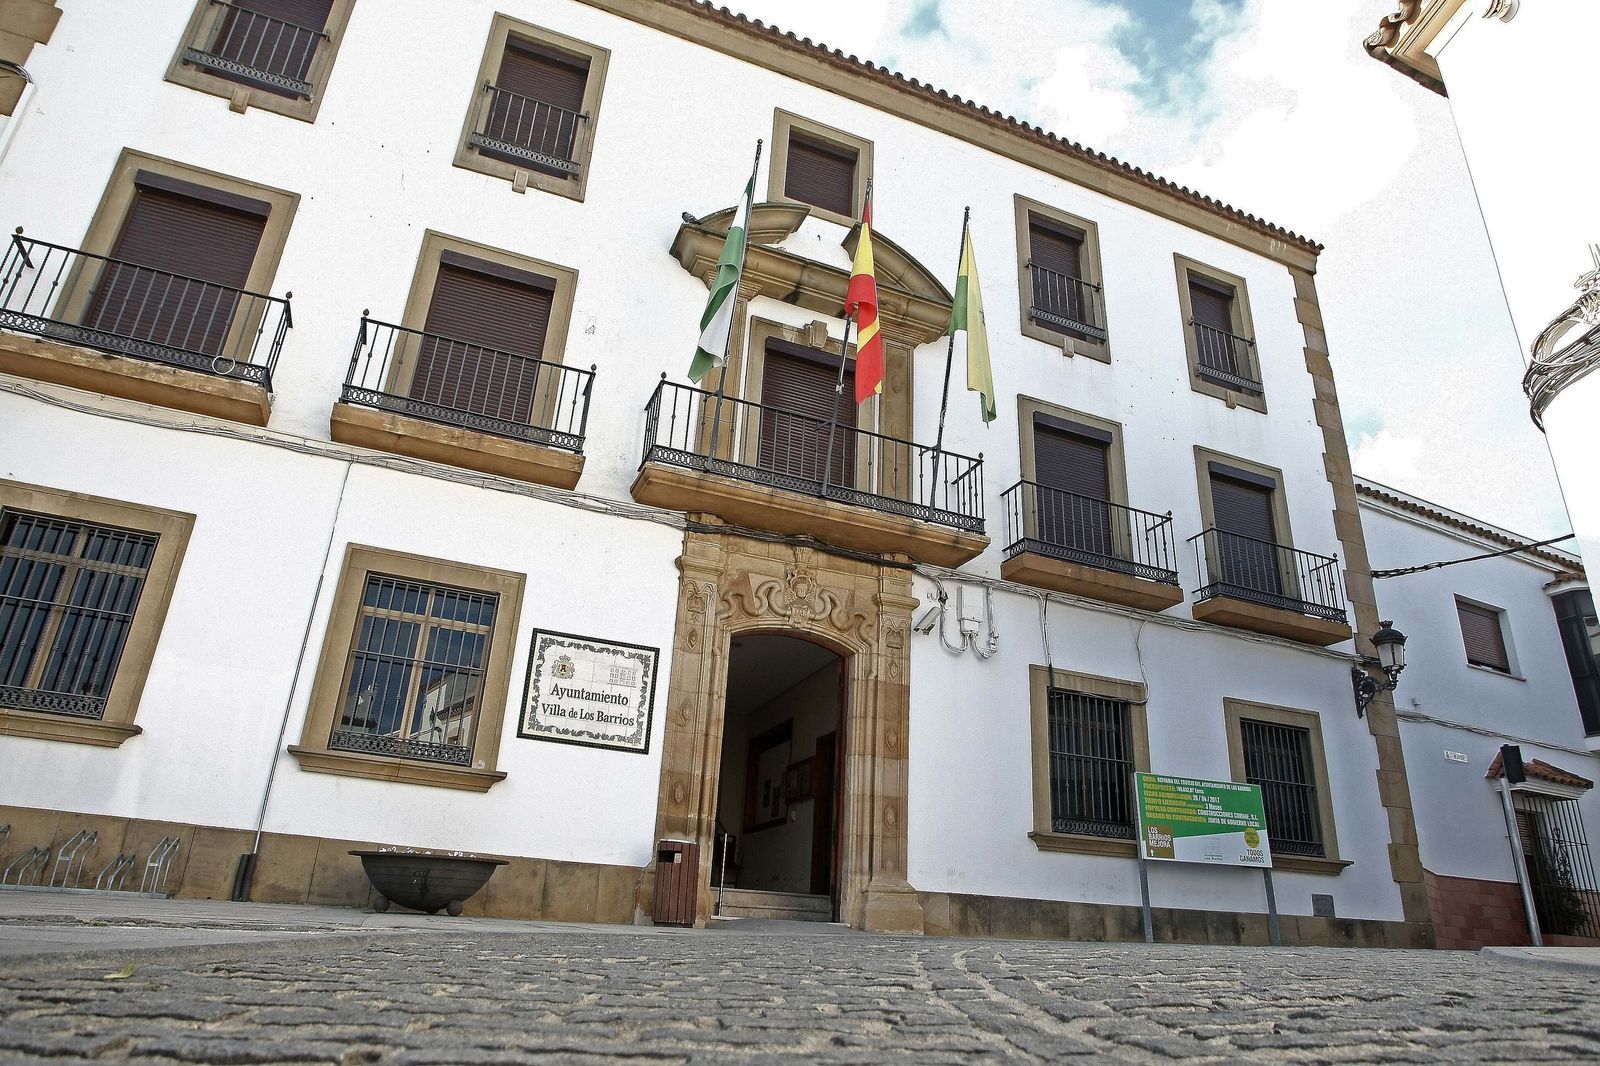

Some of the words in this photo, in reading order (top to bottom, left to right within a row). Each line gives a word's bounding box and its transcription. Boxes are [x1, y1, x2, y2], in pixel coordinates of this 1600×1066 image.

[550, 682, 629, 706] Ayuntamiento
[541, 703, 566, 718] Villa
[568, 708, 578, 719] de
[579, 709, 594, 722] Los
[596, 710, 635, 726] Barrios
[1197, 809, 1233, 817] CONSTRUCCIONES
[1148, 839, 1171, 848] MEJORA
[1239, 855, 1264, 863] GANAMOS
